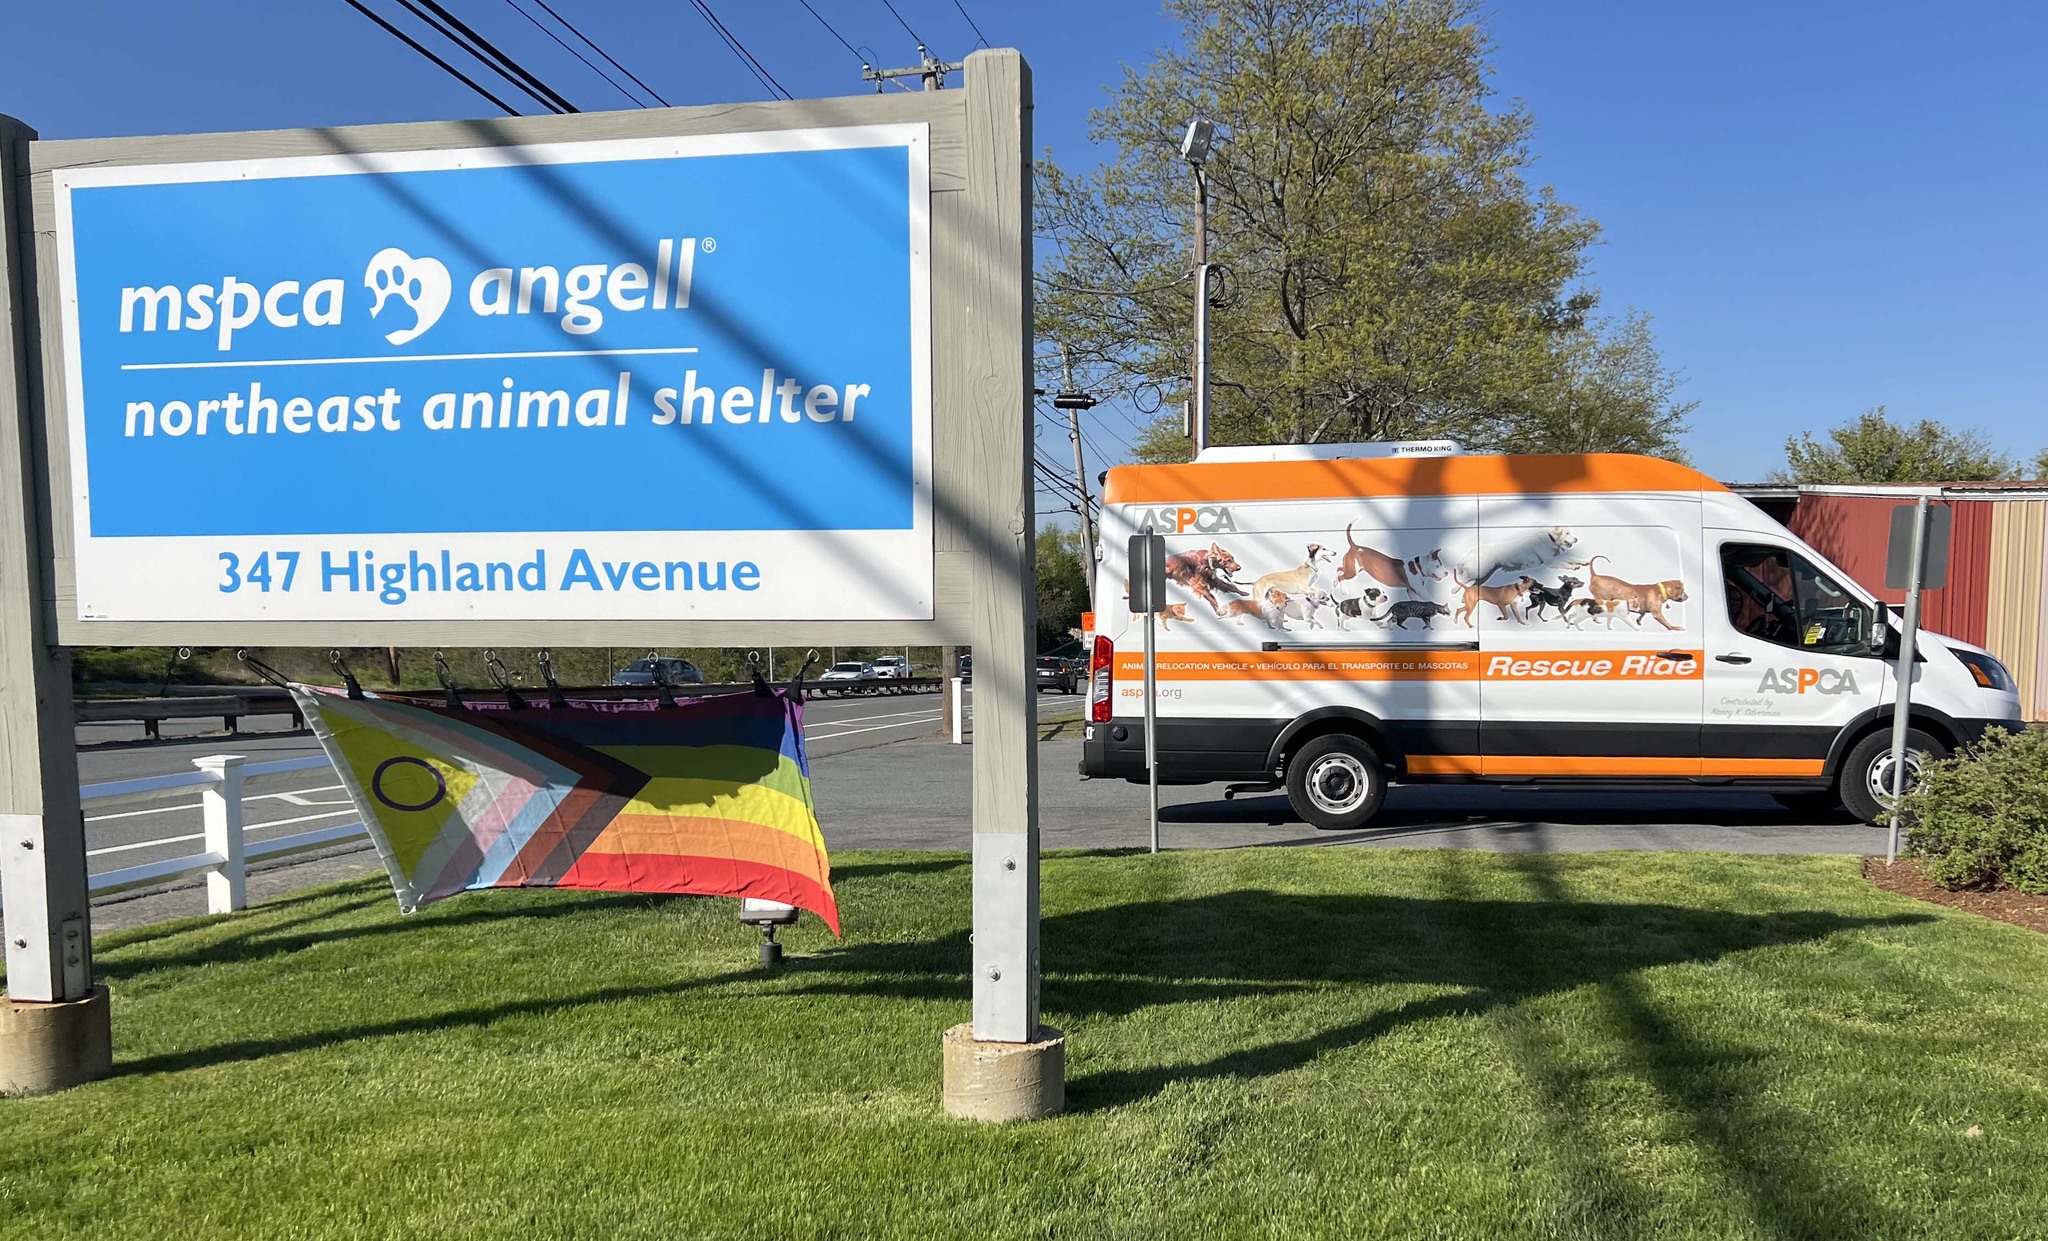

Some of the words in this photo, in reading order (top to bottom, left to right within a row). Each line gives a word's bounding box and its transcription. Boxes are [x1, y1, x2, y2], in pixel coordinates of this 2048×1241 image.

[119, 276, 345, 351] mspca
[124, 381, 402, 438] northeast
[422, 371, 631, 431] animal
[651, 368, 871, 426] shelter
[1137, 507, 1237, 533] ASPCA
[218, 551, 301, 593] 347
[320, 548, 547, 606] Highland
[559, 548, 761, 592] Avenue
[1156, 662, 1210, 670] RELOCATION
[1211, 662, 1248, 670] VEHICLE
[1302, 662, 1326, 670] PARA
[1327, 662, 1339, 670] EL
[1341, 662, 1400, 670] TRANSPORTE
[1402, 662, 1415, 670] DE
[1418, 662, 1469, 670] MASCOTAS
[1487, 656, 1613, 676] Rescue
[1121, 688, 1183, 700] asp.org
[1757, 667, 1861, 695] ASPCA
[1764, 697, 1774, 709] by
